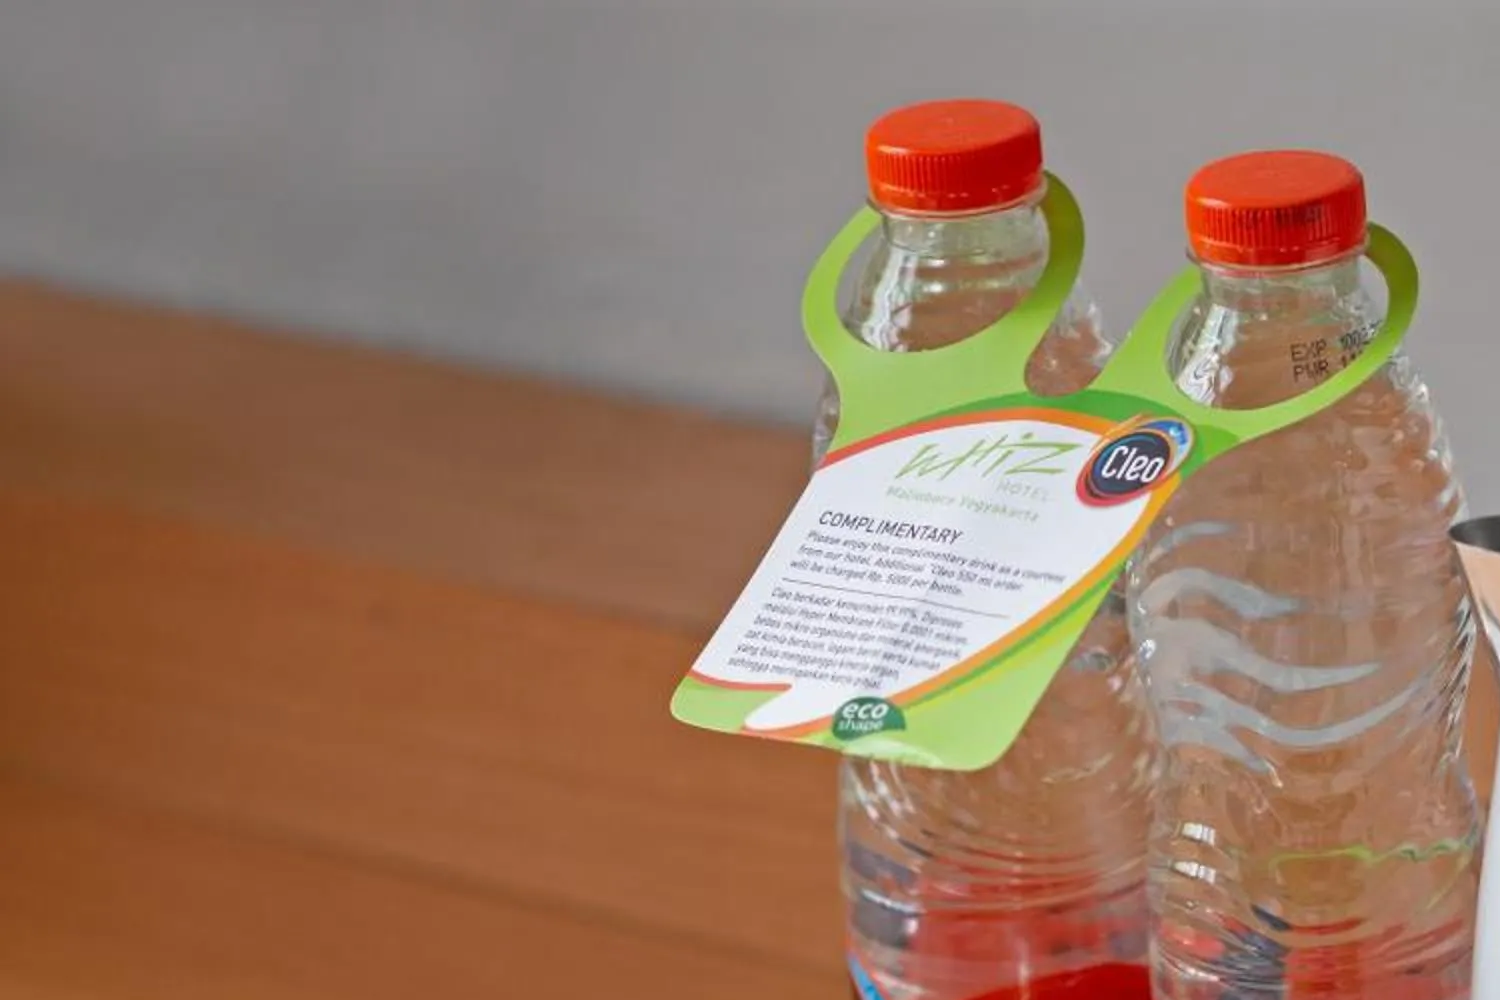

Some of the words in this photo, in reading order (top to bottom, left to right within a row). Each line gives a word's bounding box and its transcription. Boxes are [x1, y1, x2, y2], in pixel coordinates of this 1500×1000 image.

[1289, 339, 1327, 361] EXP
[1101, 445, 1165, 483] Cleo
[996, 480, 1050, 503] HOTEL
[819, 509, 963, 545] COMPLIMENTARY
[799, 543, 824, 556] from
[808, 530, 841, 545] Please
[842, 539, 869, 551] enjoy
[891, 546, 967, 567] complimentary
[967, 557, 997, 572] drink
[998, 564, 1011, 574] as
[789, 560, 810, 570] will
[810, 561, 823, 573] be
[825, 565, 866, 580] charged
[771, 586, 793, 600] Cleo
[842, 703, 889, 719] eco
[838, 718, 883, 735] shape
